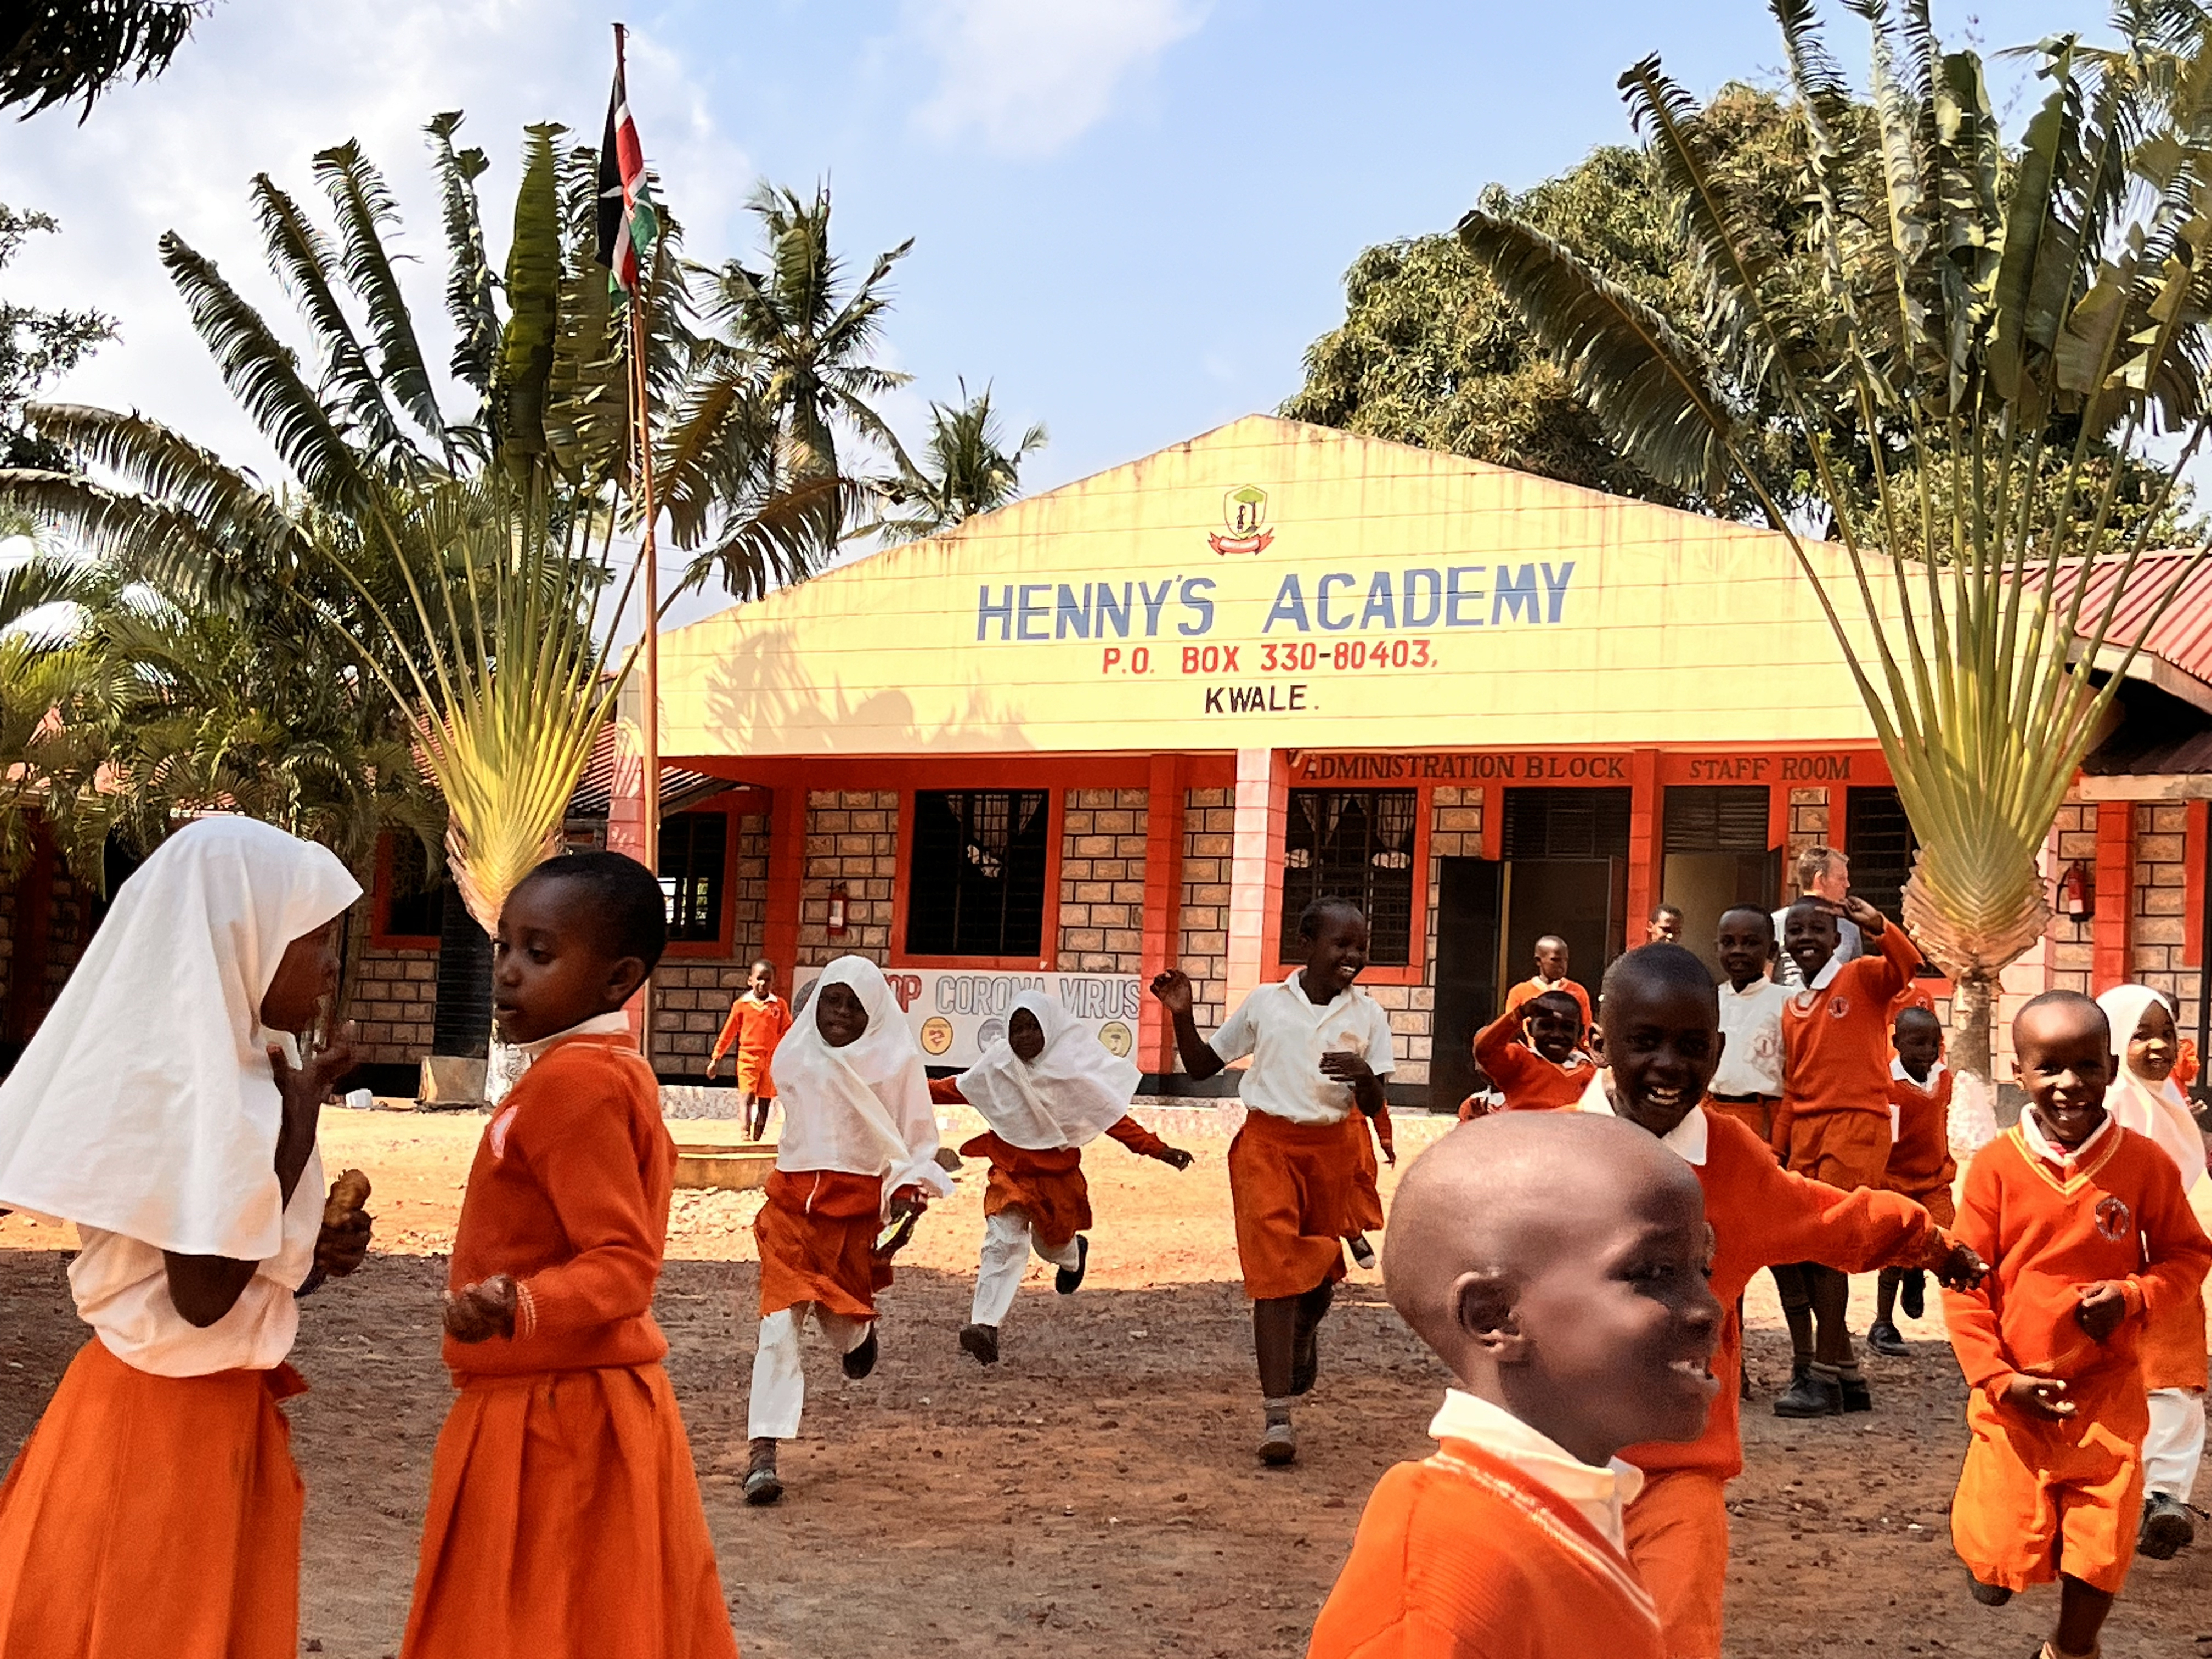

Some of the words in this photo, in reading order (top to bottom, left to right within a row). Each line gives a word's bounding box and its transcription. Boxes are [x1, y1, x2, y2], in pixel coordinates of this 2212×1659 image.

[977, 574, 1216, 641] HENNY'S
[1262, 561, 1576, 633] ACADEMY
[1102, 647, 1155, 674] P.O.
[1182, 645, 1240, 674] BOX
[1261, 640, 1438, 672] 330-80403,
[1205, 685, 1319, 714] KWALE.
[1301, 755, 1516, 780] ADMINISTRATION
[1523, 755, 1626, 778] BLOCK
[1689, 757, 1771, 780] STAFF
[1781, 755, 1852, 780] ROOM
[1059, 977, 1140, 1020] VIRUS
